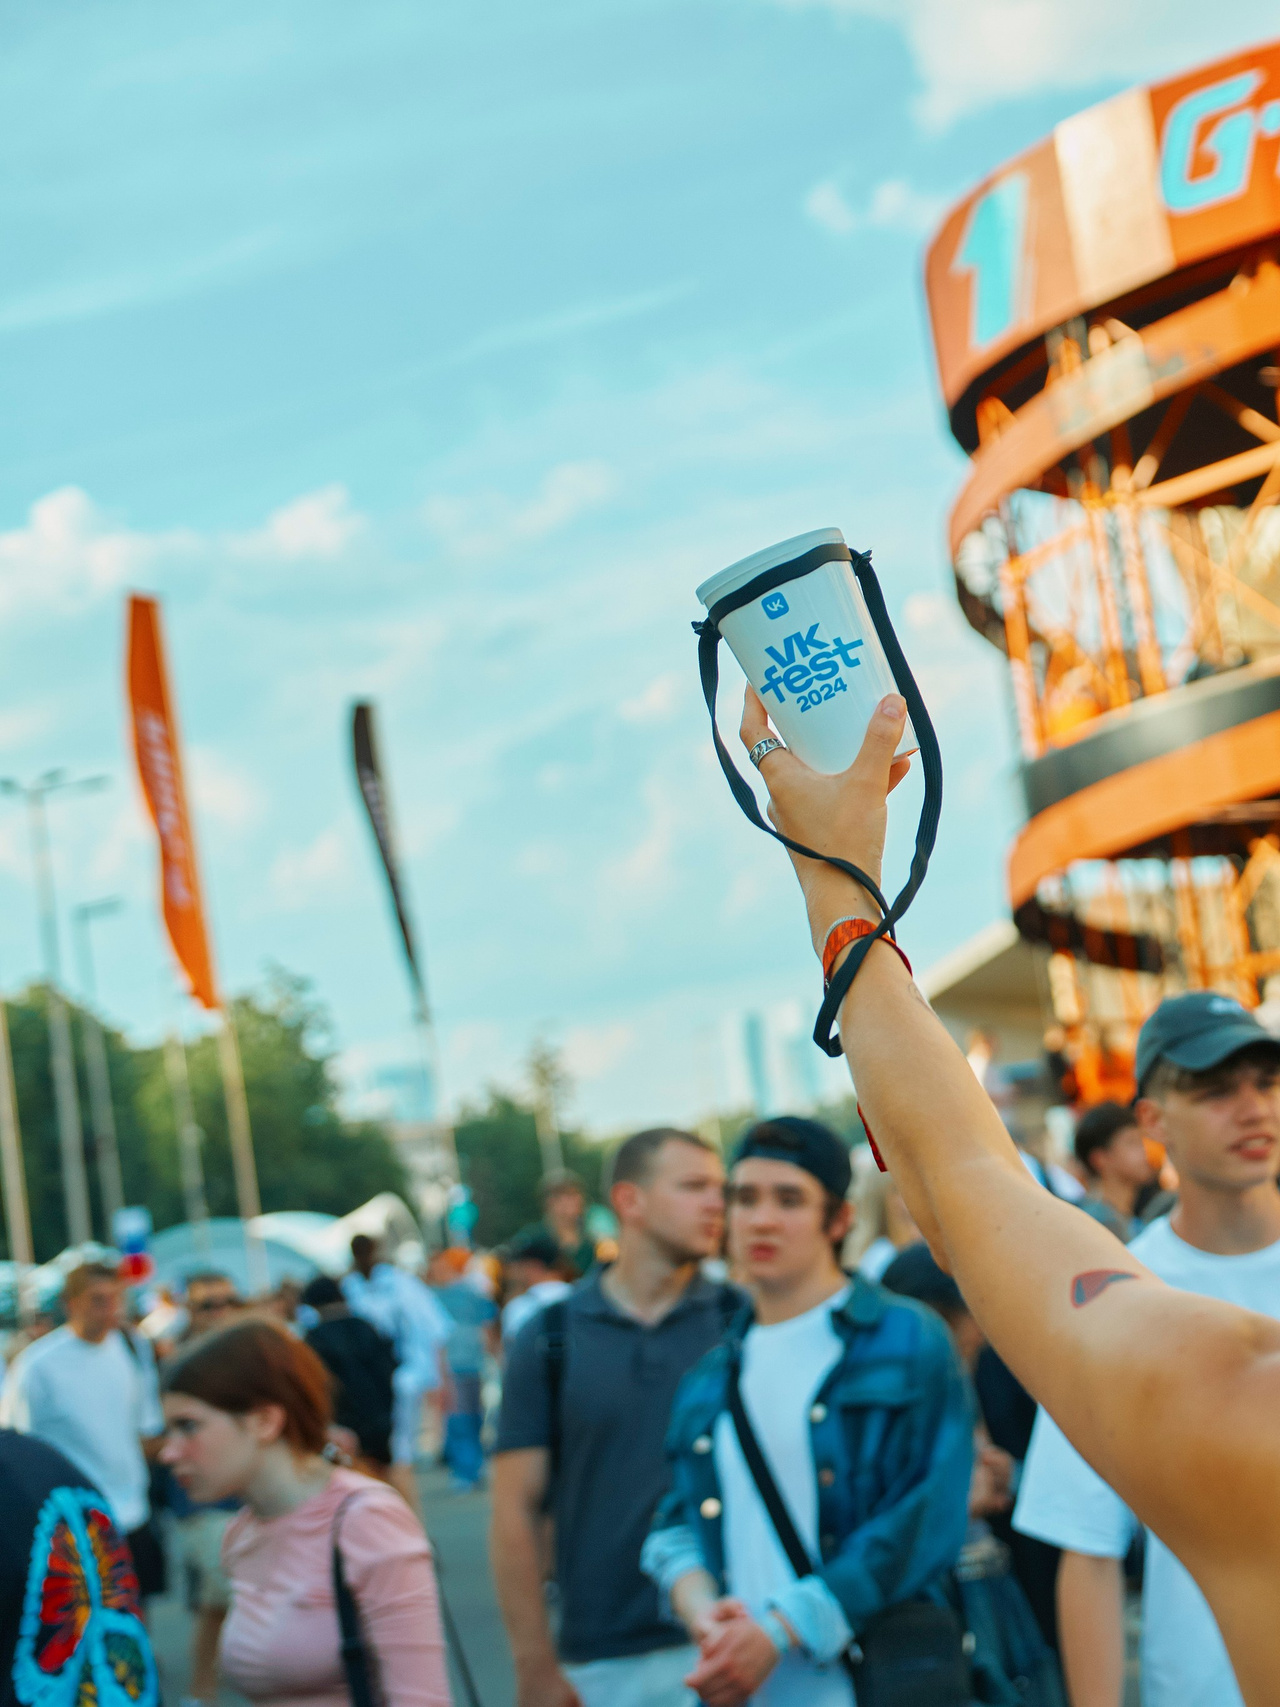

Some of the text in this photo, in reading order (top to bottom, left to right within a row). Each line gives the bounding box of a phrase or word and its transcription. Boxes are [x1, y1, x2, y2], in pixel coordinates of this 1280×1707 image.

[764, 622, 831, 669] VK
[760, 636, 864, 704] fest
[796, 676, 848, 713] 2024
